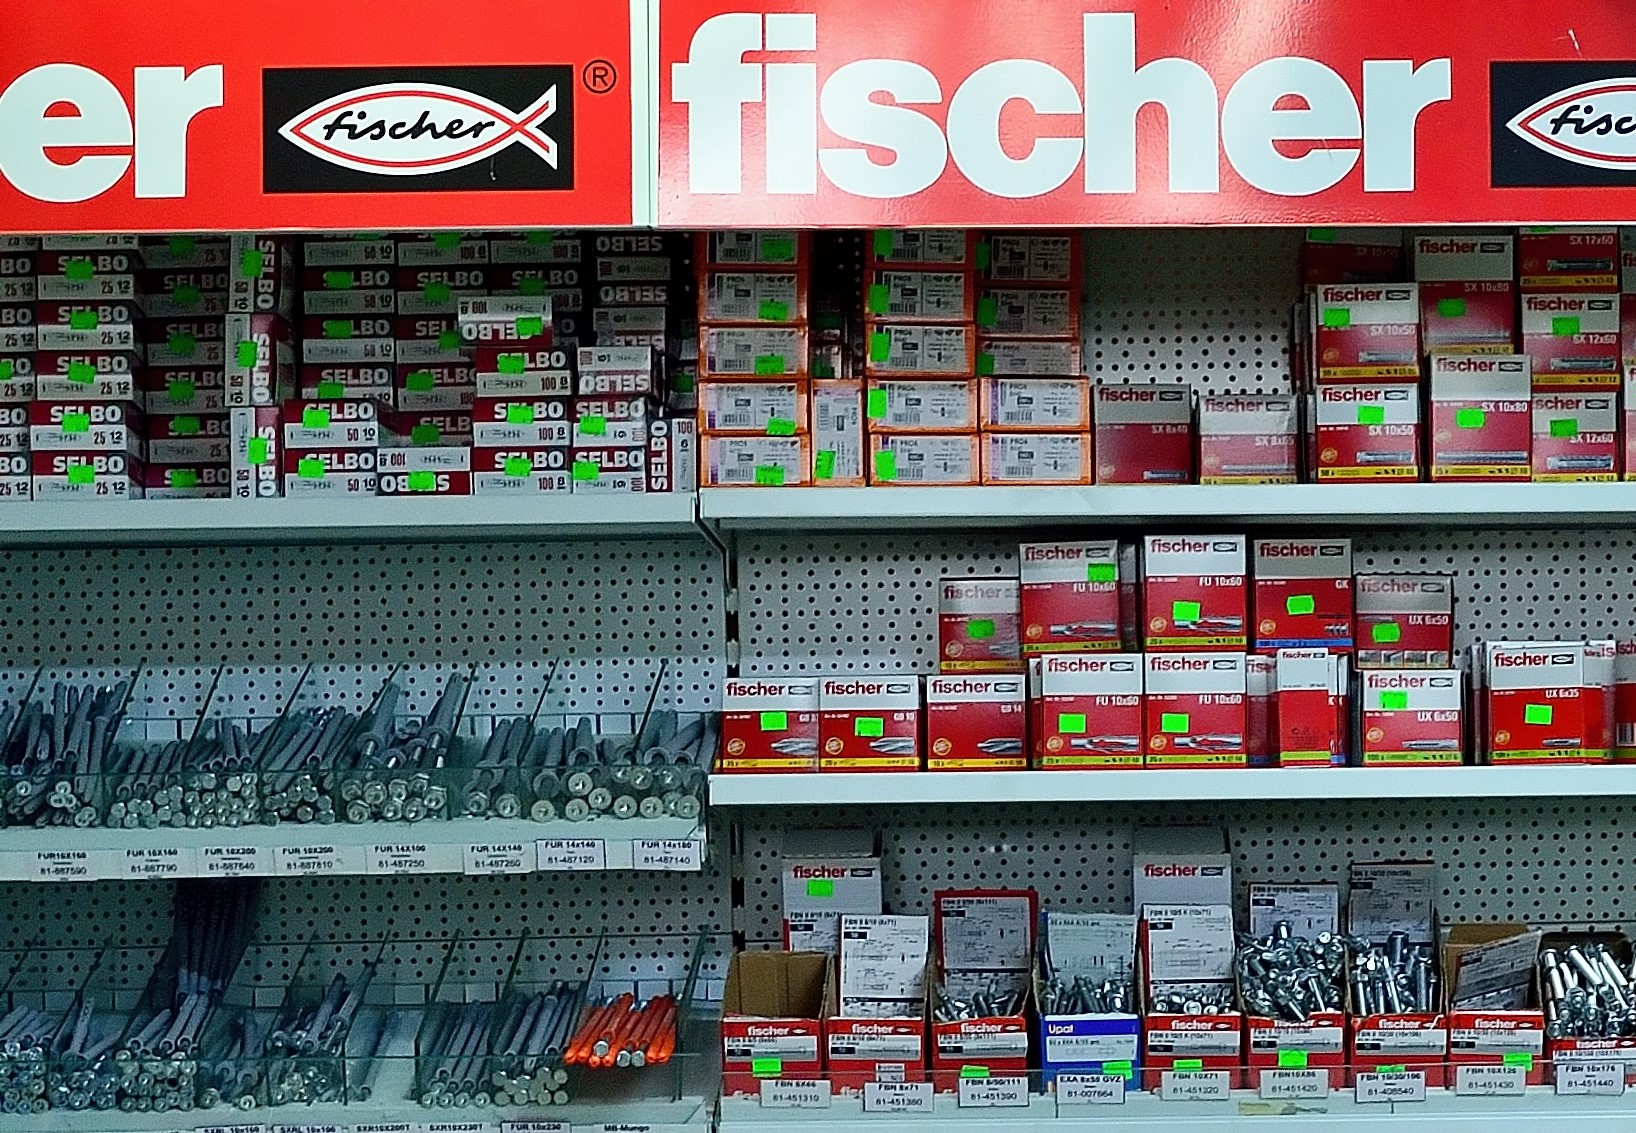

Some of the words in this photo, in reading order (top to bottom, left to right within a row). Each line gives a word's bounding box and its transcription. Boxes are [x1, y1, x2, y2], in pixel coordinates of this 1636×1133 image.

[671, 12, 1452, 198] fischer
[324, 111, 495, 141] fischer
[1419, 240, 1478, 254] fischer
[600, 286, 667, 302] SELBO
[1323, 287, 1382, 302] fischer
[1526, 297, 1585, 312] fischer
[101, 331, 113, 345] 25
[321, 368, 390, 384] SELBO
[540, 377, 556, 390] 100
[580, 375, 650, 392] SELBO
[1099, 387, 1156, 402] fischer
[1321, 387, 1382, 402] fischer
[576, 401, 646, 418] SELBO
[1204, 399, 1264, 414] fischer
[347, 428, 359, 442] 50
[363, 428, 376, 438] 10
[1368, 425, 1382, 436] SX
[1385, 424, 1414, 436] 10x50
[651, 420, 668, 490] SELBO
[1024, 546, 1082, 562] fischer
[1151, 539, 1210, 555] fischer
[1260, 542, 1318, 558] fischer
[1360, 578, 1418, 594] fischer
[1047, 658, 1106, 674] fischer
[1150, 656, 1210, 673] fischer
[1494, 652, 1550, 668] fischer
[726, 682, 785, 698] fischer
[824, 681, 884, 697] fischer
[932, 679, 990, 696] fischer
[1367, 674, 1426, 690] fischer
[792, 864, 848, 879] fischer
[1144, 864, 1198, 878] fischer
[1048, 1024, 1073, 1034] Upat
[1378, 1019, 1420, 1030] fischer
